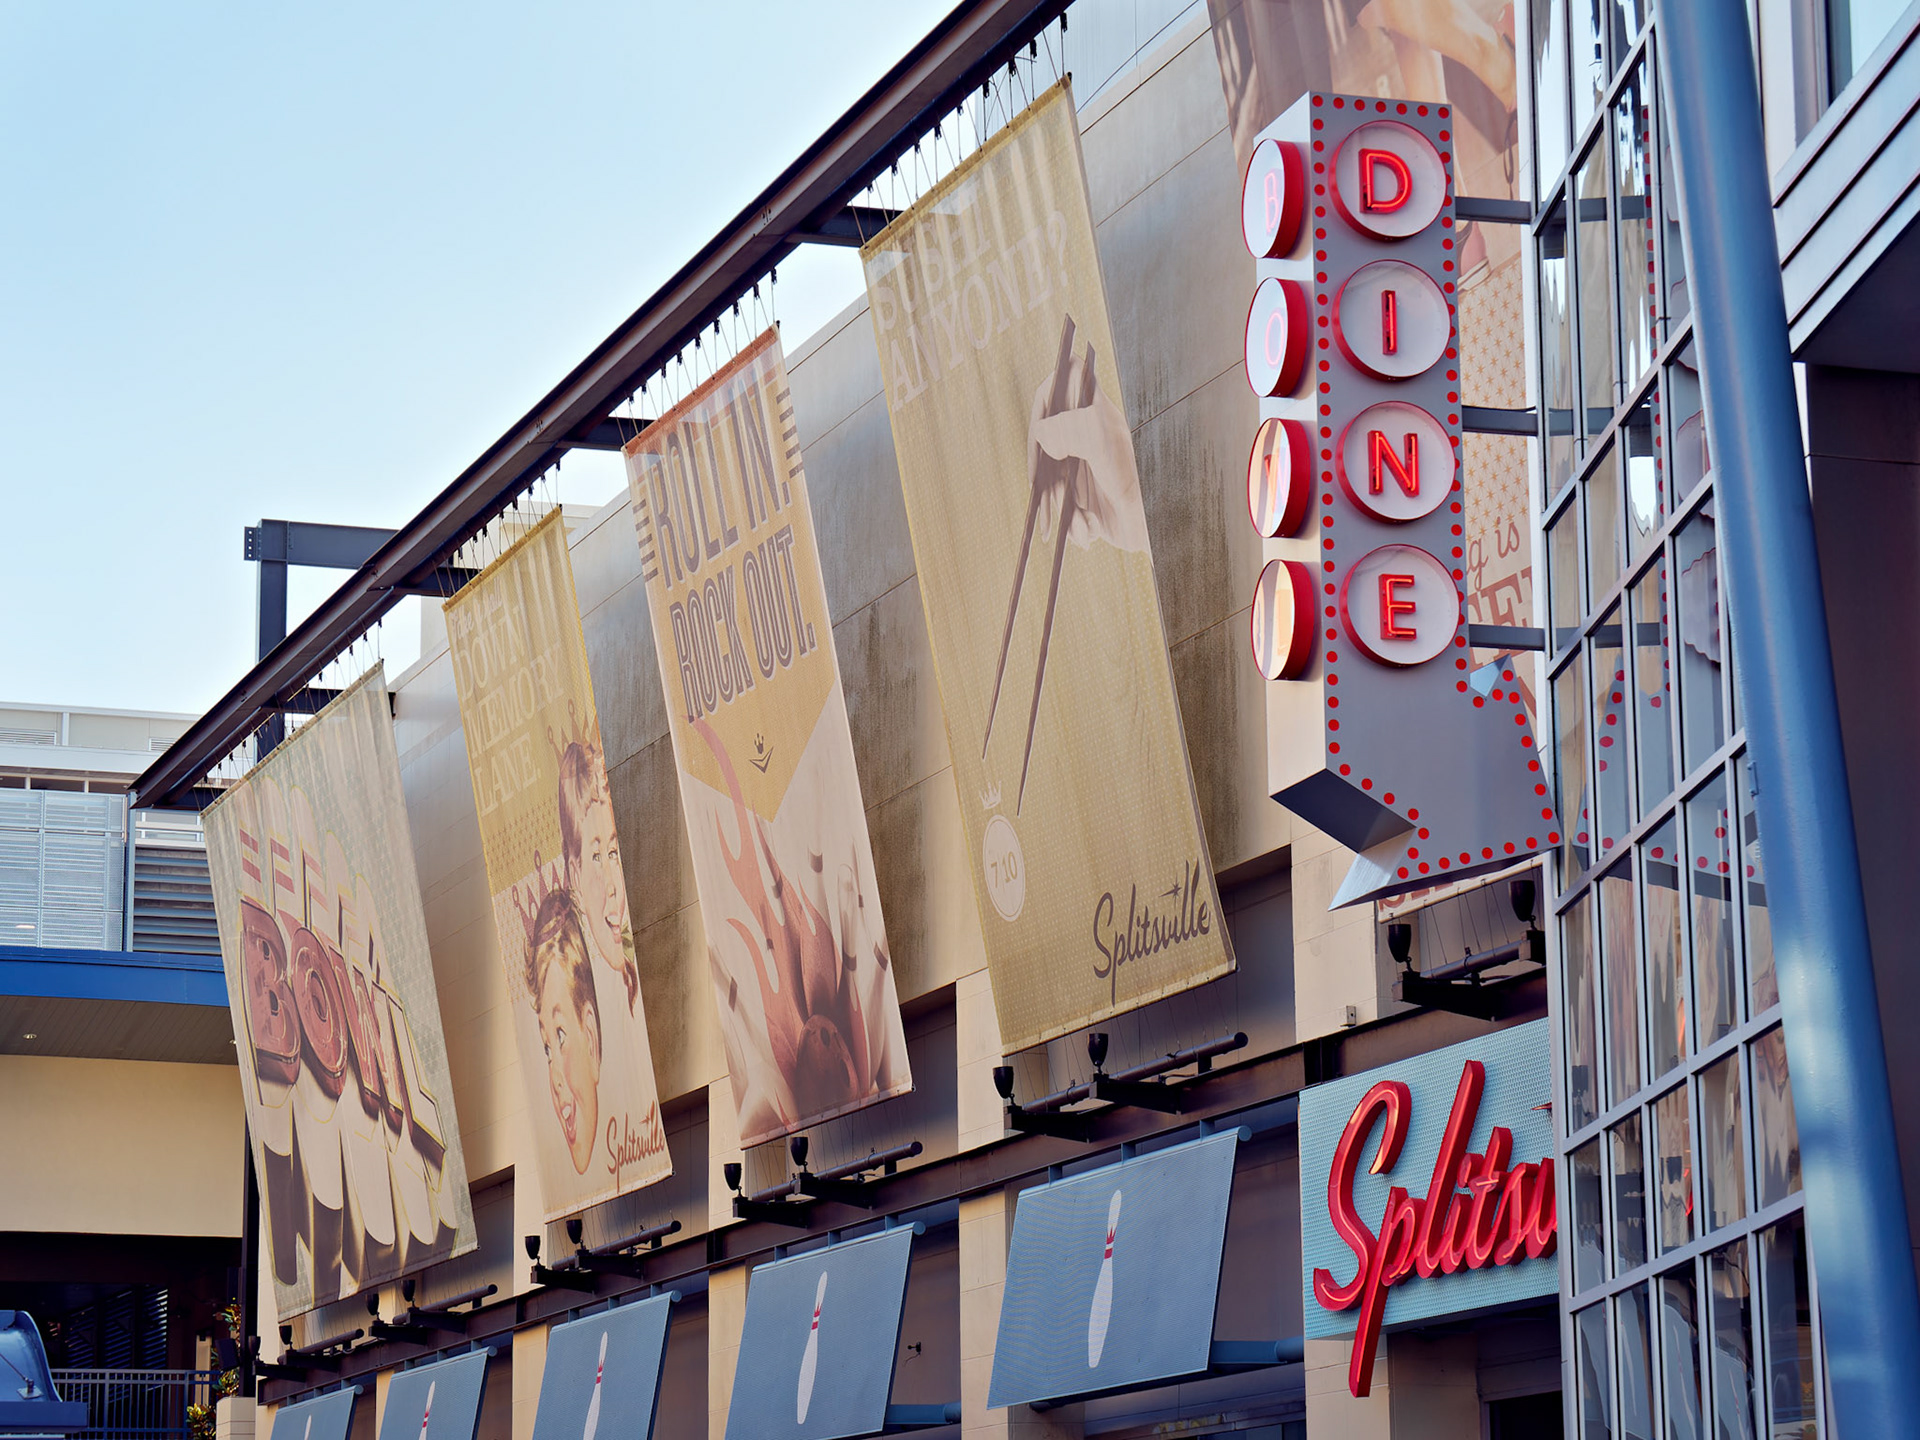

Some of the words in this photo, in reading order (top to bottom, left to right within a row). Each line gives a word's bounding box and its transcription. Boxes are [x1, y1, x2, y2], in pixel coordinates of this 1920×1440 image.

[872, 180, 992, 334] SUSHI
[888, 210, 1069, 413] ANYONE?
[1358, 147, 1420, 641] DINE
[648, 407, 740, 590] ROLL
[728, 366, 793, 531] IN.
[1494, 516, 1521, 559] is
[454, 605, 526, 703] DOWN
[464, 641, 565, 760] MEMORY
[669, 564, 756, 725] ROCK
[743, 523, 818, 682] OUT.
[474, 731, 542, 818] LANE.
[1093, 856, 1212, 1009] Splitsville
[606, 1100, 666, 1195] Splitsville
